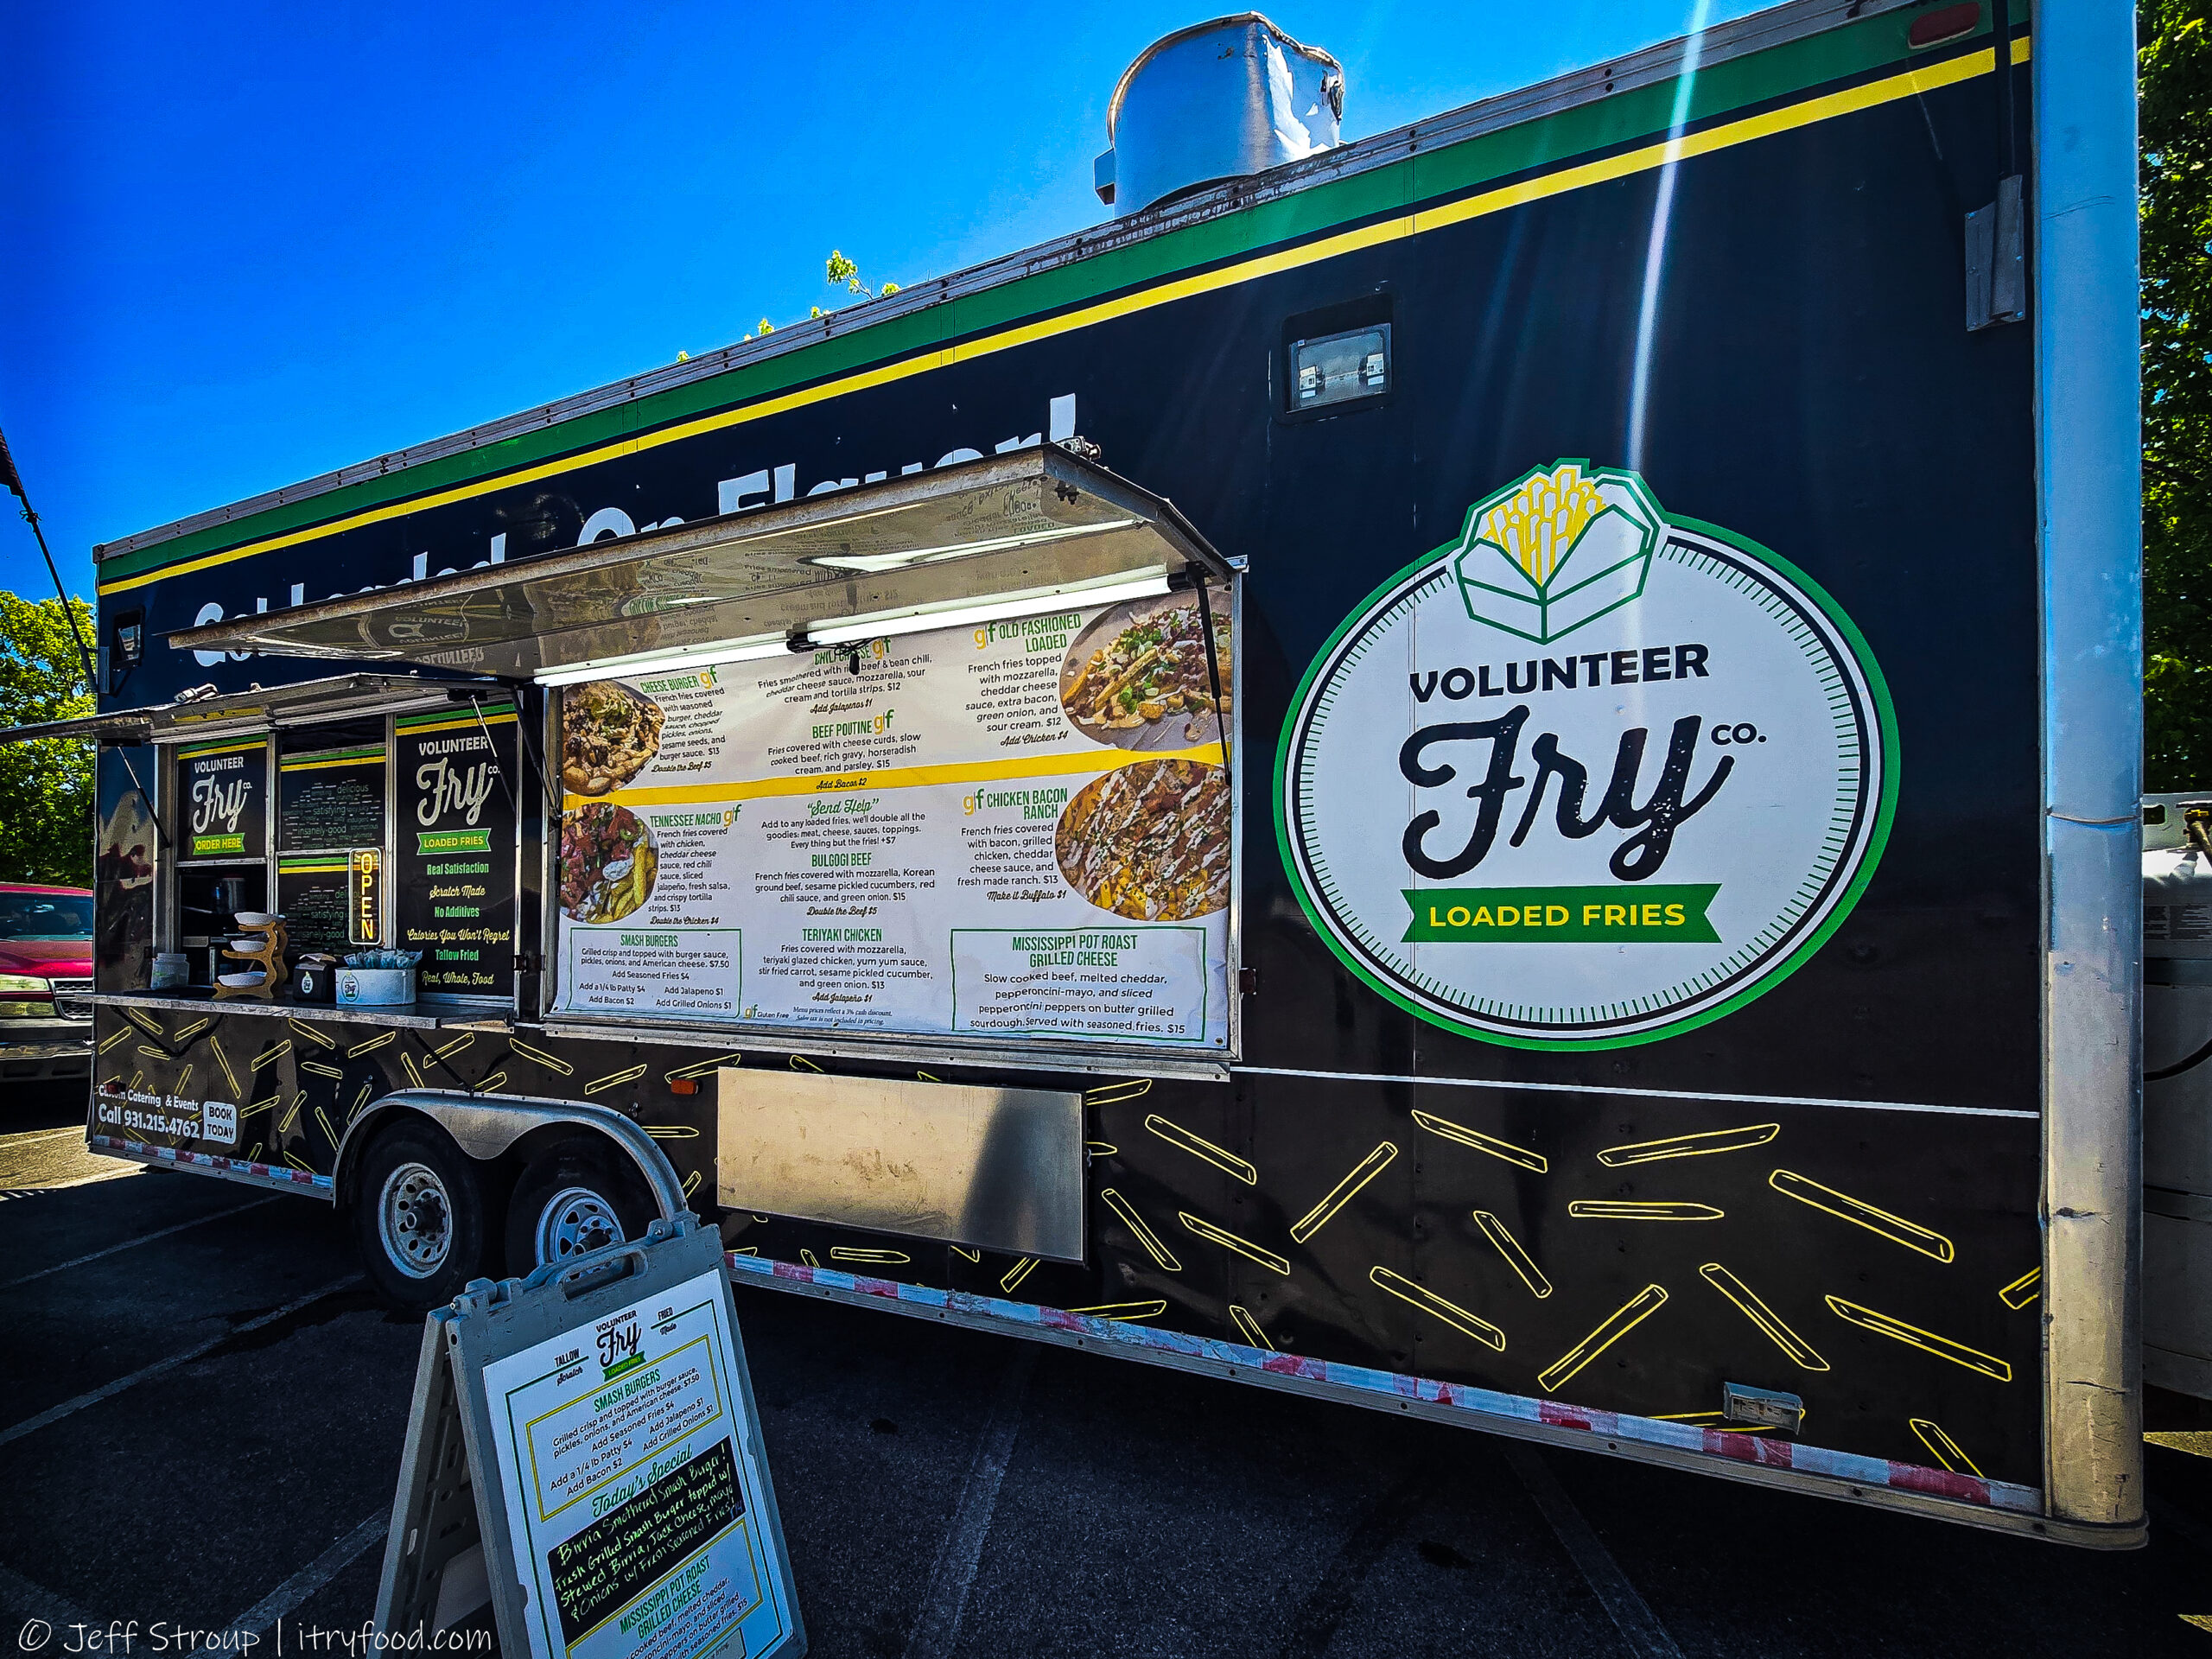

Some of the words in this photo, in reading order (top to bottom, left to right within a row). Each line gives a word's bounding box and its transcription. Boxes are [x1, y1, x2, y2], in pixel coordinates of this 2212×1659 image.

[1000, 623, 1019, 640] OLD
[1022, 613, 1081, 636] FASHIONED
[1026, 633, 1067, 652] LOADED
[968, 661, 1000, 673] French
[1002, 659, 1023, 669] fries
[1026, 654, 1062, 667] topped
[979, 674, 1000, 684] with
[1003, 668, 1058, 681] mozzarella,
[1409, 644, 1709, 703] VOLUNTEER
[640, 679, 669, 693] CHEESE
[670, 676, 700, 690] BURGER
[981, 685, 1020, 696] cheddar
[1022, 682, 1057, 692] cheese
[965, 702, 995, 710] sauce,
[997, 698, 1021, 707] extra
[1024, 695, 1057, 704] bacon,
[976, 712, 1004, 722] green
[1007, 708, 1036, 718] onion,
[1039, 704, 1058, 715] and
[812, 724, 834, 739] BEEF
[836, 720, 872, 736] POUTINE
[987, 723, 1007, 732] sour
[1010, 721, 1043, 730] cream.
[1046, 716, 1061, 727] $12
[419, 736, 489, 755] VOLUNTEER
[1000, 735, 1021, 747] Add
[1022, 733, 1056, 744] Chicken
[1058, 730, 1069, 740] $4
[771, 754, 798, 766] cooked
[800, 753, 822, 762] beef,
[823, 752, 840, 760] rich
[842, 751, 865, 761] gravy,
[868, 744, 916, 757] horseradish
[194, 756, 244, 773] VOLUNTEER
[416, 758, 493, 826] Fry
[816, 780, 833, 790] Add
[834, 779, 857, 788] Bacon
[1399, 704, 1735, 881] Fry
[193, 774, 247, 834] Fry
[987, 791, 1029, 808] CHICKEN
[1033, 788, 1067, 804] BACON
[650, 814, 694, 828] TENNESSEE
[695, 812, 721, 825] NACHO
[1024, 804, 1058, 820] RANCH
[962, 826, 991, 836] French
[994, 825, 1013, 835] fries
[1015, 823, 1053, 833] covered
[195, 839, 220, 851] ORDER
[223, 838, 242, 849] HERE
[424, 837, 458, 848] LOADED
[461, 836, 483, 845] FRIES
[812, 853, 849, 867] BULGOGI
[851, 852, 872, 866] BEEF
[427, 863, 443, 875] Real
[444, 862, 489, 874] Satisfaction
[957, 877, 981, 886] fresh
[983, 876, 1008, 885] made
[1011, 875, 1040, 884] ranch.
[1043, 875, 1058, 884] $13
[361, 853, 373, 940] OPEN
[429, 885, 461, 899] Scratch
[461, 885, 486, 899] Made
[987, 891, 1011, 902] Make
[1012, 891, 1020, 899] it
[1020, 889, 1056, 902] Buffalo
[1057, 890, 1066, 899] $1
[435, 906, 444, 918] No
[445, 906, 480, 917] Additives
[806, 906, 835, 915] Double
[848, 906, 868, 918] Beef
[868, 906, 878, 915] $5
[1429, 906, 1569, 927] LOADED
[1583, 904, 1686, 925] FRIES
[407, 928, 438, 940] Calories
[439, 929, 457, 944] You
[457, 928, 481, 940] Won't
[482, 928, 510, 944] Regret
[620, 934, 644, 946] SMASH
[645, 935, 678, 947] BURGERS
[802, 929, 842, 941] TERIYAKI
[844, 928, 881, 942] CHICKEN
[1013, 935, 1075, 950] MISSISSIPPI
[1079, 934, 1100, 949] POT
[1102, 935, 1138, 950] ROAST
[435, 949, 459, 960] Tallow
[460, 950, 479, 961] Fried
[1030, 951, 1074, 968] GRILLED
[1077, 951, 1117, 966] CHEESE
[423, 970, 441, 985] Real,
[442, 971, 470, 985] Whole,
[472, 972, 494, 985] Food
[984, 974, 1007, 982] Slow
[1010, 971, 1048, 982] cooked
[1052, 971, 1077, 982] beef,
[1080, 973, 1117, 982] melted
[1121, 974, 1166, 984] cheddar,
[128, 1090, 162, 1107] Catering
[165, 1095, 172, 1107] &
[174, 1096, 198, 1111] Events
[99, 1103, 121, 1124] Call
[124, 1109, 200, 1138] 931.215.4762
[208, 1106, 232, 1121] BOOK
[207, 1123, 234, 1139] TODAY
[596, 1310, 637, 1332] VOLUNTEER
[658, 1307, 673, 1321] FRIED
[596, 1322, 641, 1368] Fry
[554, 1348, 580, 1367] TALLOW
[609, 1362, 628, 1375] LOADED
[628, 1357, 641, 1365] FRIES
[594, 1387, 624, 1413] SMASH
[625, 1369, 661, 1397] BURGERS
[592, 1436, 608, 1452] Add
[610, 1415, 645, 1441] Seasoned
[647, 1407, 664, 1421] Fries
[665, 1401, 674, 1410] $4
[647, 1443, 693, 1487] Special
[620, 1590, 670, 1633] MISSISSIPPI
[669, 1579, 684, 1601] POT
[685, 1555, 710, 1587] ROAST
[638, 1605, 671, 1639] GRILLED
[672, 1581, 702, 1614] CHEESE
